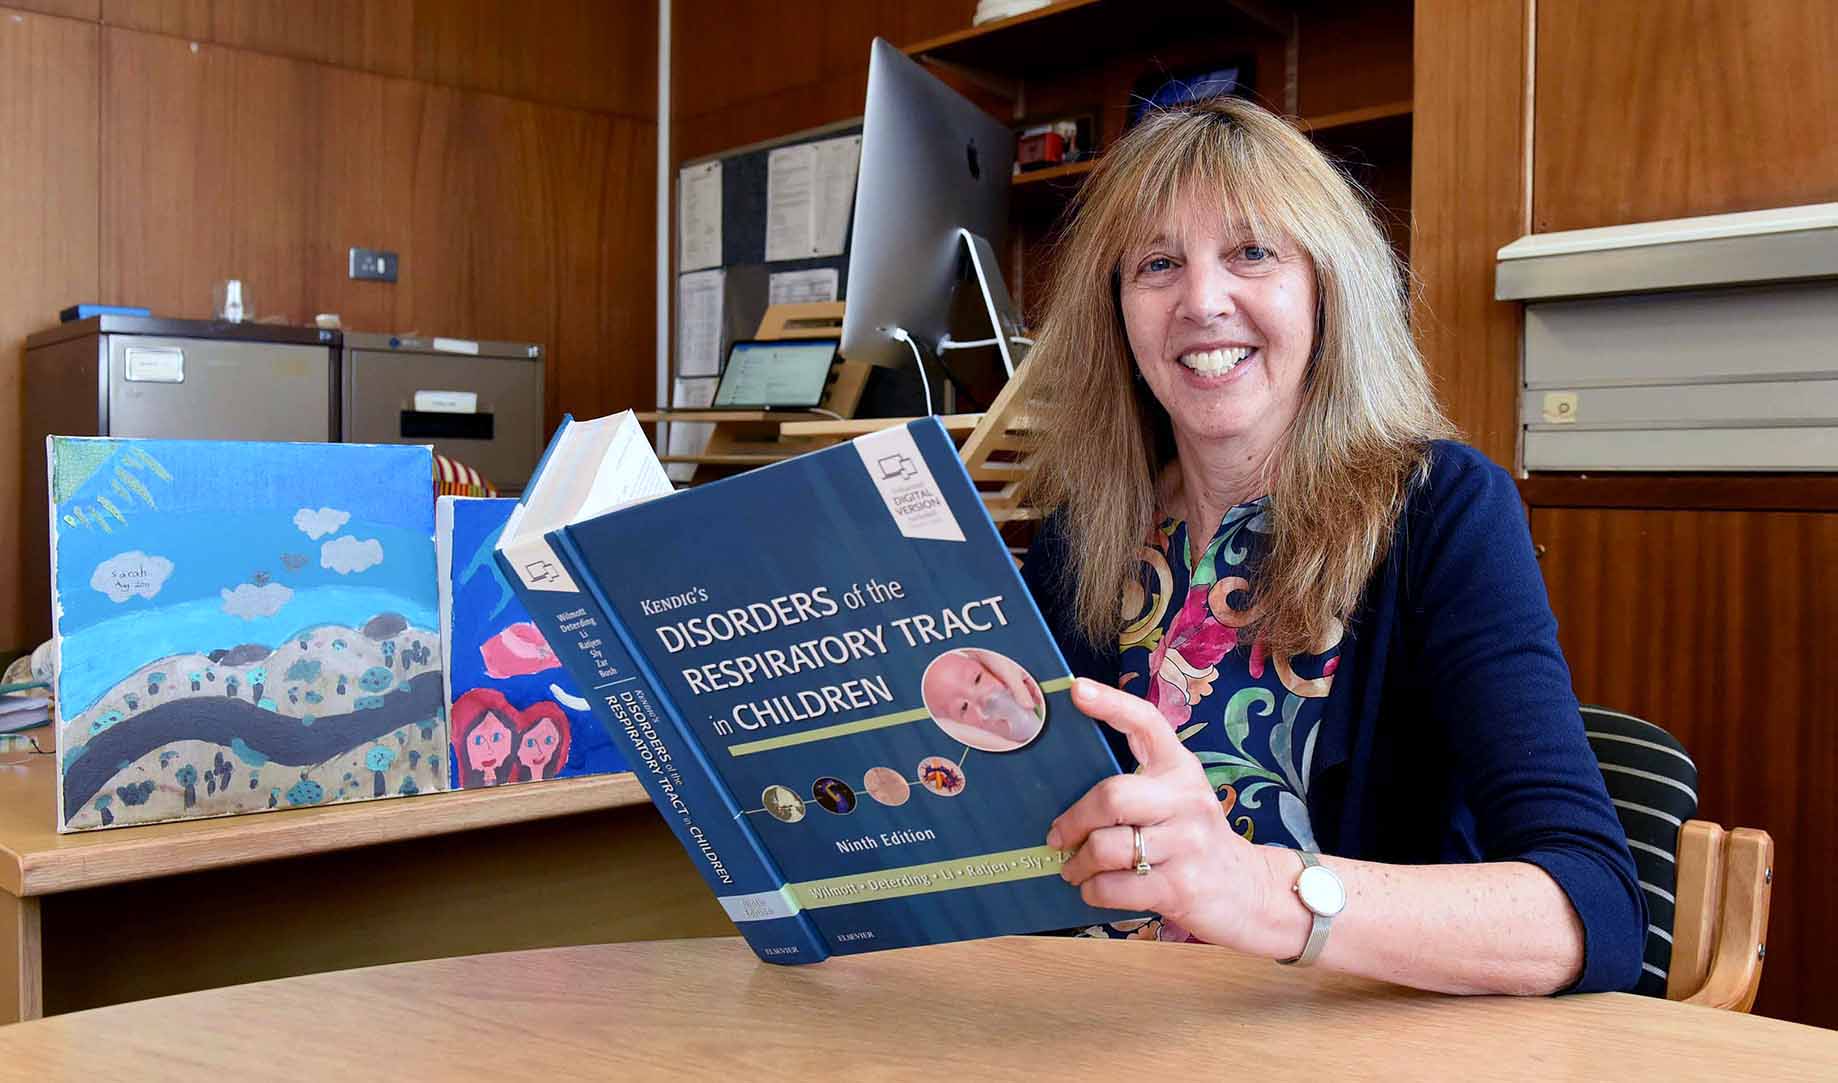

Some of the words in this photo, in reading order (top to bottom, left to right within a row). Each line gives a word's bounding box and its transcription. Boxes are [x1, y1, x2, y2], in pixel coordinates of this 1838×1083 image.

[894, 490, 934, 505] DIGITAL
[895, 497, 940, 515] VERSION
[655, 586, 839, 653] DISORDERS
[843, 583, 866, 609] of
[866, 578, 905, 604] the
[682, 624, 888, 695] RESPIRATORY
[891, 595, 1008, 648] TRACT
[620, 691, 672, 763] DISORDERS
[708, 714, 734, 736] in
[732, 675, 894, 731] CHILDREN
[604, 695, 664, 776] RESPIRATORY
[658, 776, 689, 815] TRACT
[689, 825, 733, 884] CHILDREN
[835, 835, 878, 853] Ninth
[880, 828, 936, 847] Edition
[809, 882, 857, 899] Wilmott
[868, 872, 932, 891] Deterding
[1020, 855, 1043, 870] Sly
